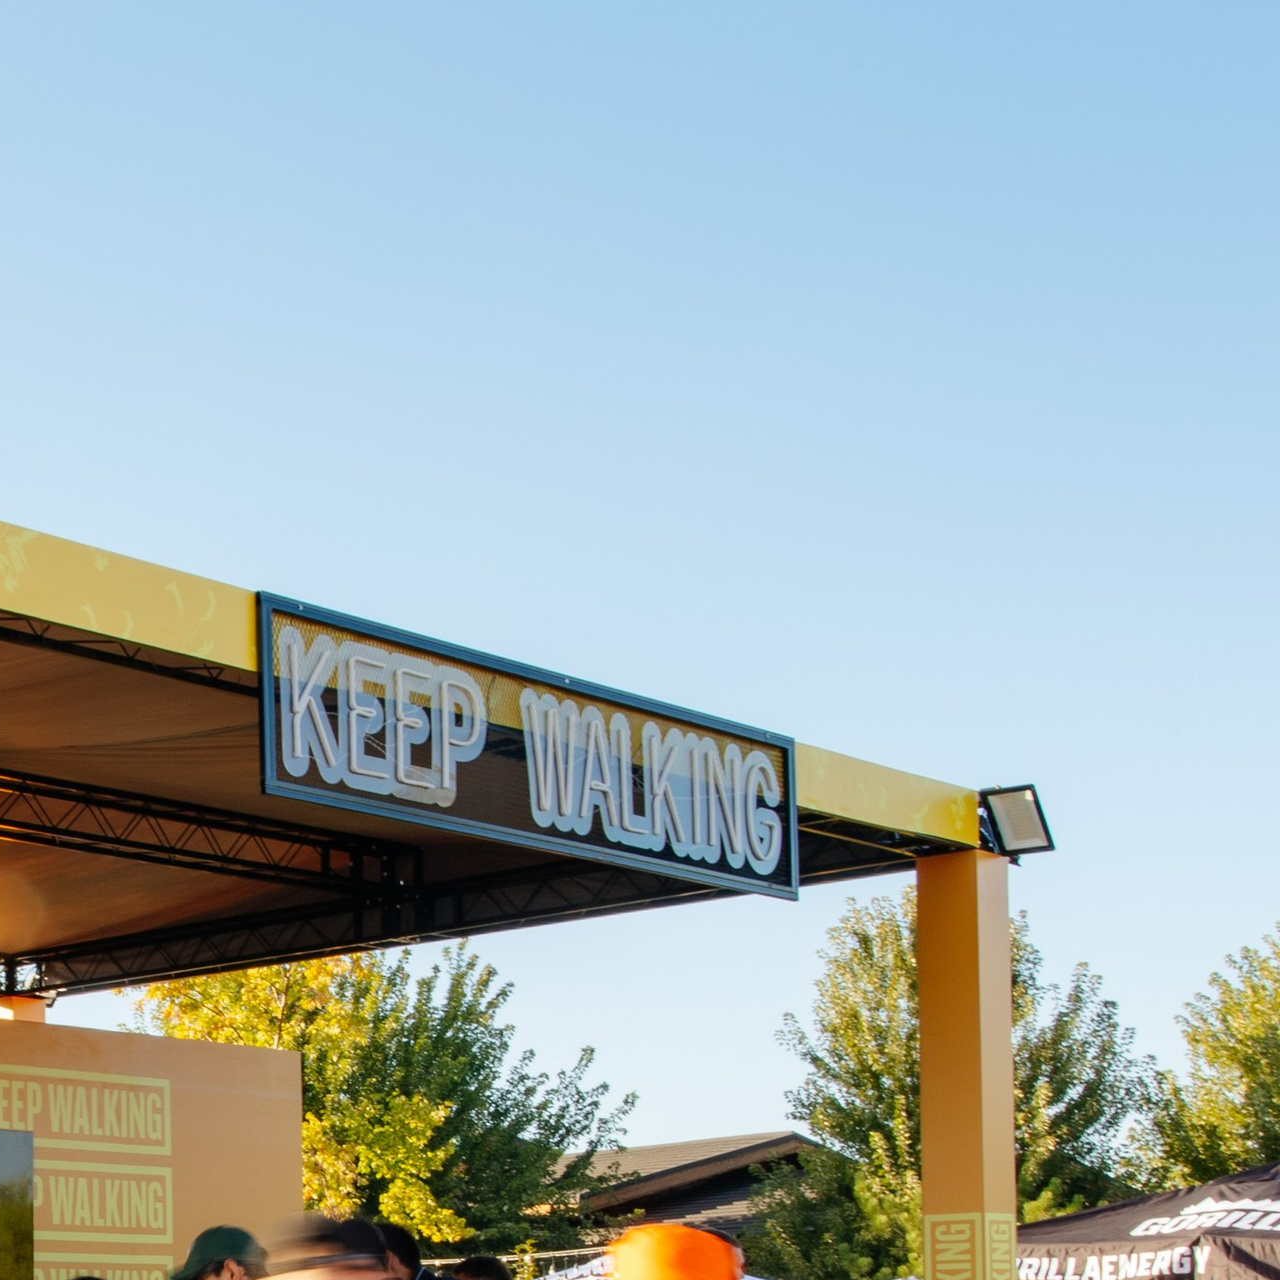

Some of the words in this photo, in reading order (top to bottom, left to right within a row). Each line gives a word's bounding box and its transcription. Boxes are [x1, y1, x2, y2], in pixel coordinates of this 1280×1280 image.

[279, 626, 487, 807] KEEP
[520, 688, 781, 875] WALKING
[47, 1084, 163, 1141] WALKING
[49, 1175, 164, 1229] WALKING
[1129, 1209, 1280, 1237] GORILL
